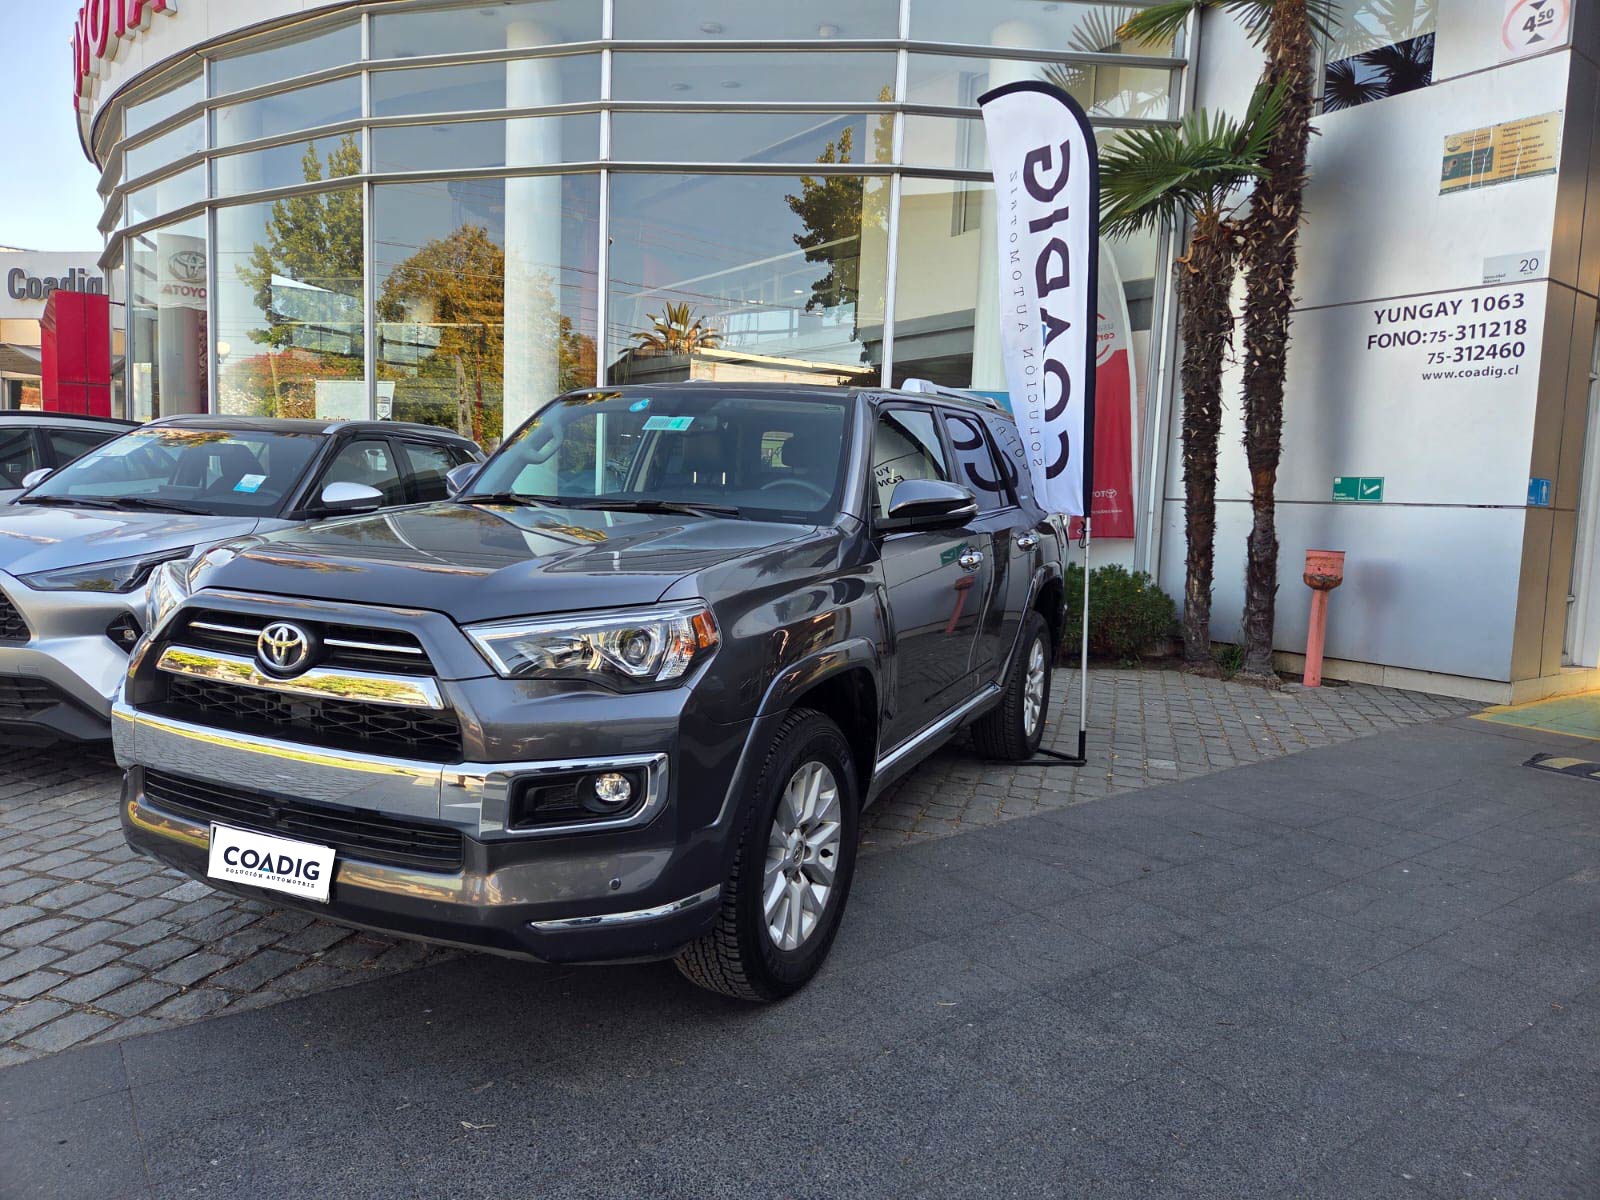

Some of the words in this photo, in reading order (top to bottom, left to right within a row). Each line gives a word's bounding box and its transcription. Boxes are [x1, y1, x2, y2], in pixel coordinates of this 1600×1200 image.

[1519, 258, 1539, 273] 20
[1373, 299, 1463, 325] YUNGAY
[1470, 292, 1526, 313] 1063
[1427, 341, 1526, 365] 75-312460
[1421, 365, 1520, 381] www.coadig.cl
[223, 846, 320, 881] COADIG
